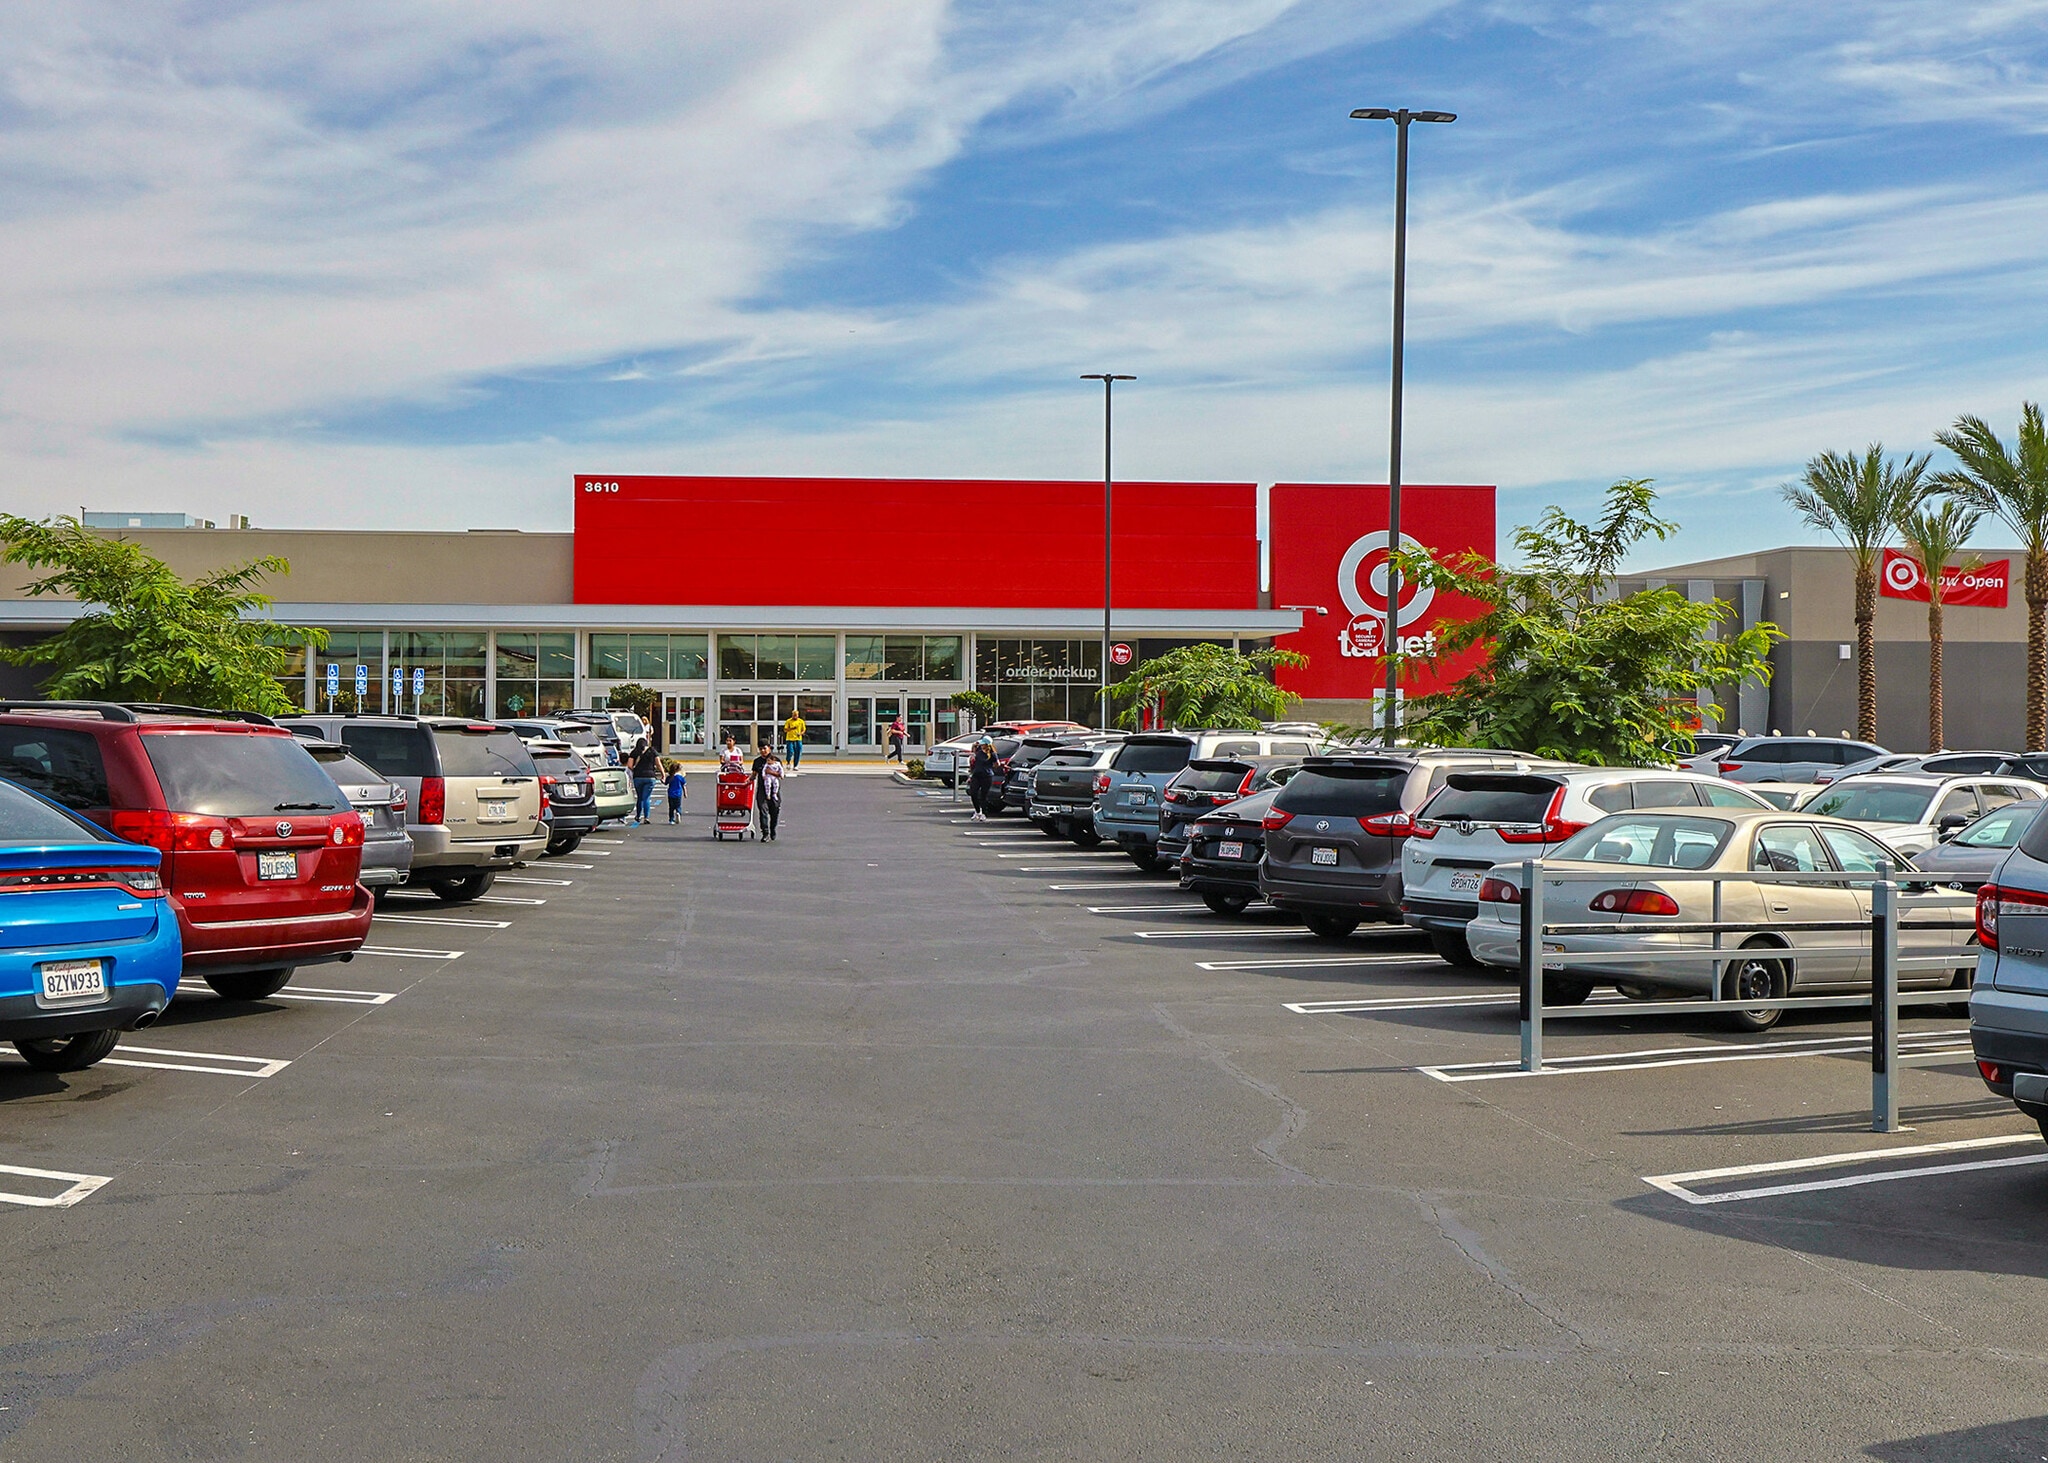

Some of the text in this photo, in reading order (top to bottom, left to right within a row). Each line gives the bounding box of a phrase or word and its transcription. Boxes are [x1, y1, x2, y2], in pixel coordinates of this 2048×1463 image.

[585, 482, 619, 493] 3610
[1963, 575, 2004, 590] Open
[1338, 630, 1437, 661] tet
[1006, 665, 1097, 680] order pickup
[2005, 946, 2046, 958] PILOT
[47, 971, 100, 993] 8ZYW933
